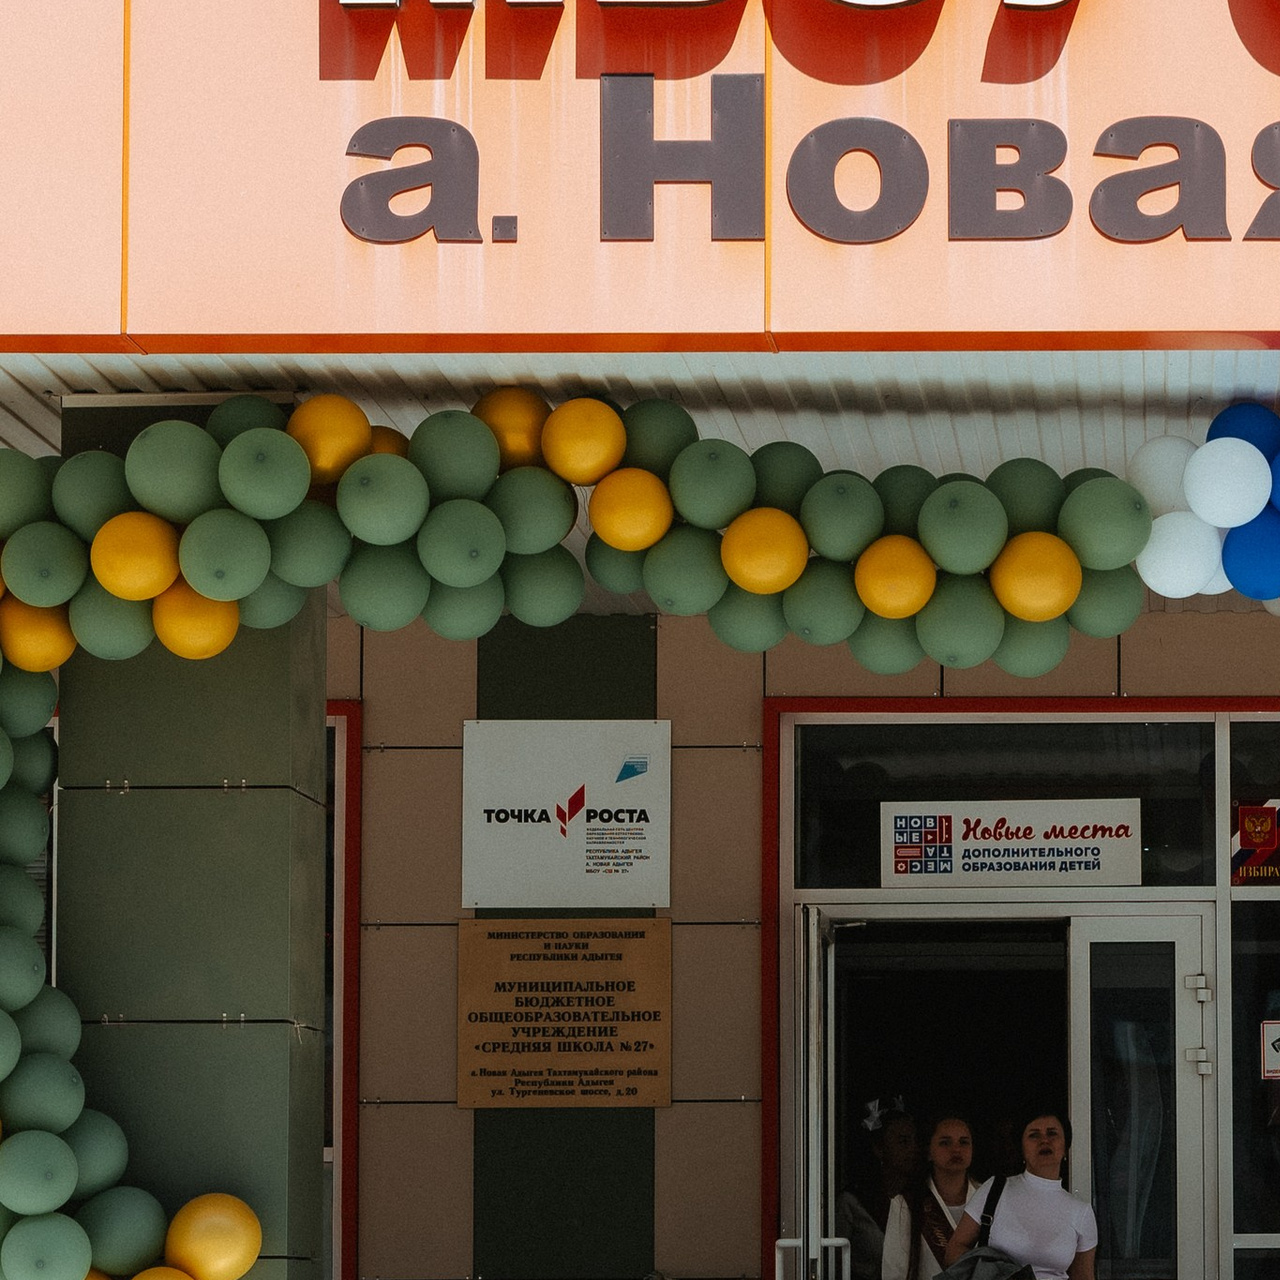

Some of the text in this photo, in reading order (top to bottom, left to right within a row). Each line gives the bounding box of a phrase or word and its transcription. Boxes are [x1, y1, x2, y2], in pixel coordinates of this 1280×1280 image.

[340, 115, 517, 244] а.
[483, 808, 650, 824] ТОЧКА РОСТА
[961, 817, 1133, 841] Новые места
[961, 847, 1101, 860] ДОПОЛНИТЕЛЬНОГО
[961, 858, 1101, 872] ОБРАЗОВАНИЯ ДЕТЕЙ
[487, 930, 646, 940] МИНИСТЕРСТВО ОБРАЗОВАНИЯ
[543, 942, 589, 950] И НАУКИ
[510, 953, 623, 962] РЕСПУБЛИКИ АДЫГЕЯ
[493, 981, 636, 994] МУНИЦИПАЛЬНОЕ
[514, 996, 616, 1009] БЮДЖЕТНОЕ
[467, 1011, 662, 1024] ОБЩЕОБРАЗОВАТЕЛЬНОЕ
[511, 1026, 619, 1039] УЧРЕЖДЕНИЕ
[474, 1042, 552, 1054] «СРЕДНЯЯ
[557, 1041, 615, 1053] ШКОЛА
[510, 1068, 544, 1078] Адыгея
[546, 1068, 624, 1079] Тахтамукайского
[626, 1068, 659, 1078] района
[514, 1077, 615, 1089] Республики Адыгея
[491, 1089, 505, 1098] ул.
[509, 1087, 577, 1098] Тургеневское
[580, 1089, 612, 1097] шоссе,
